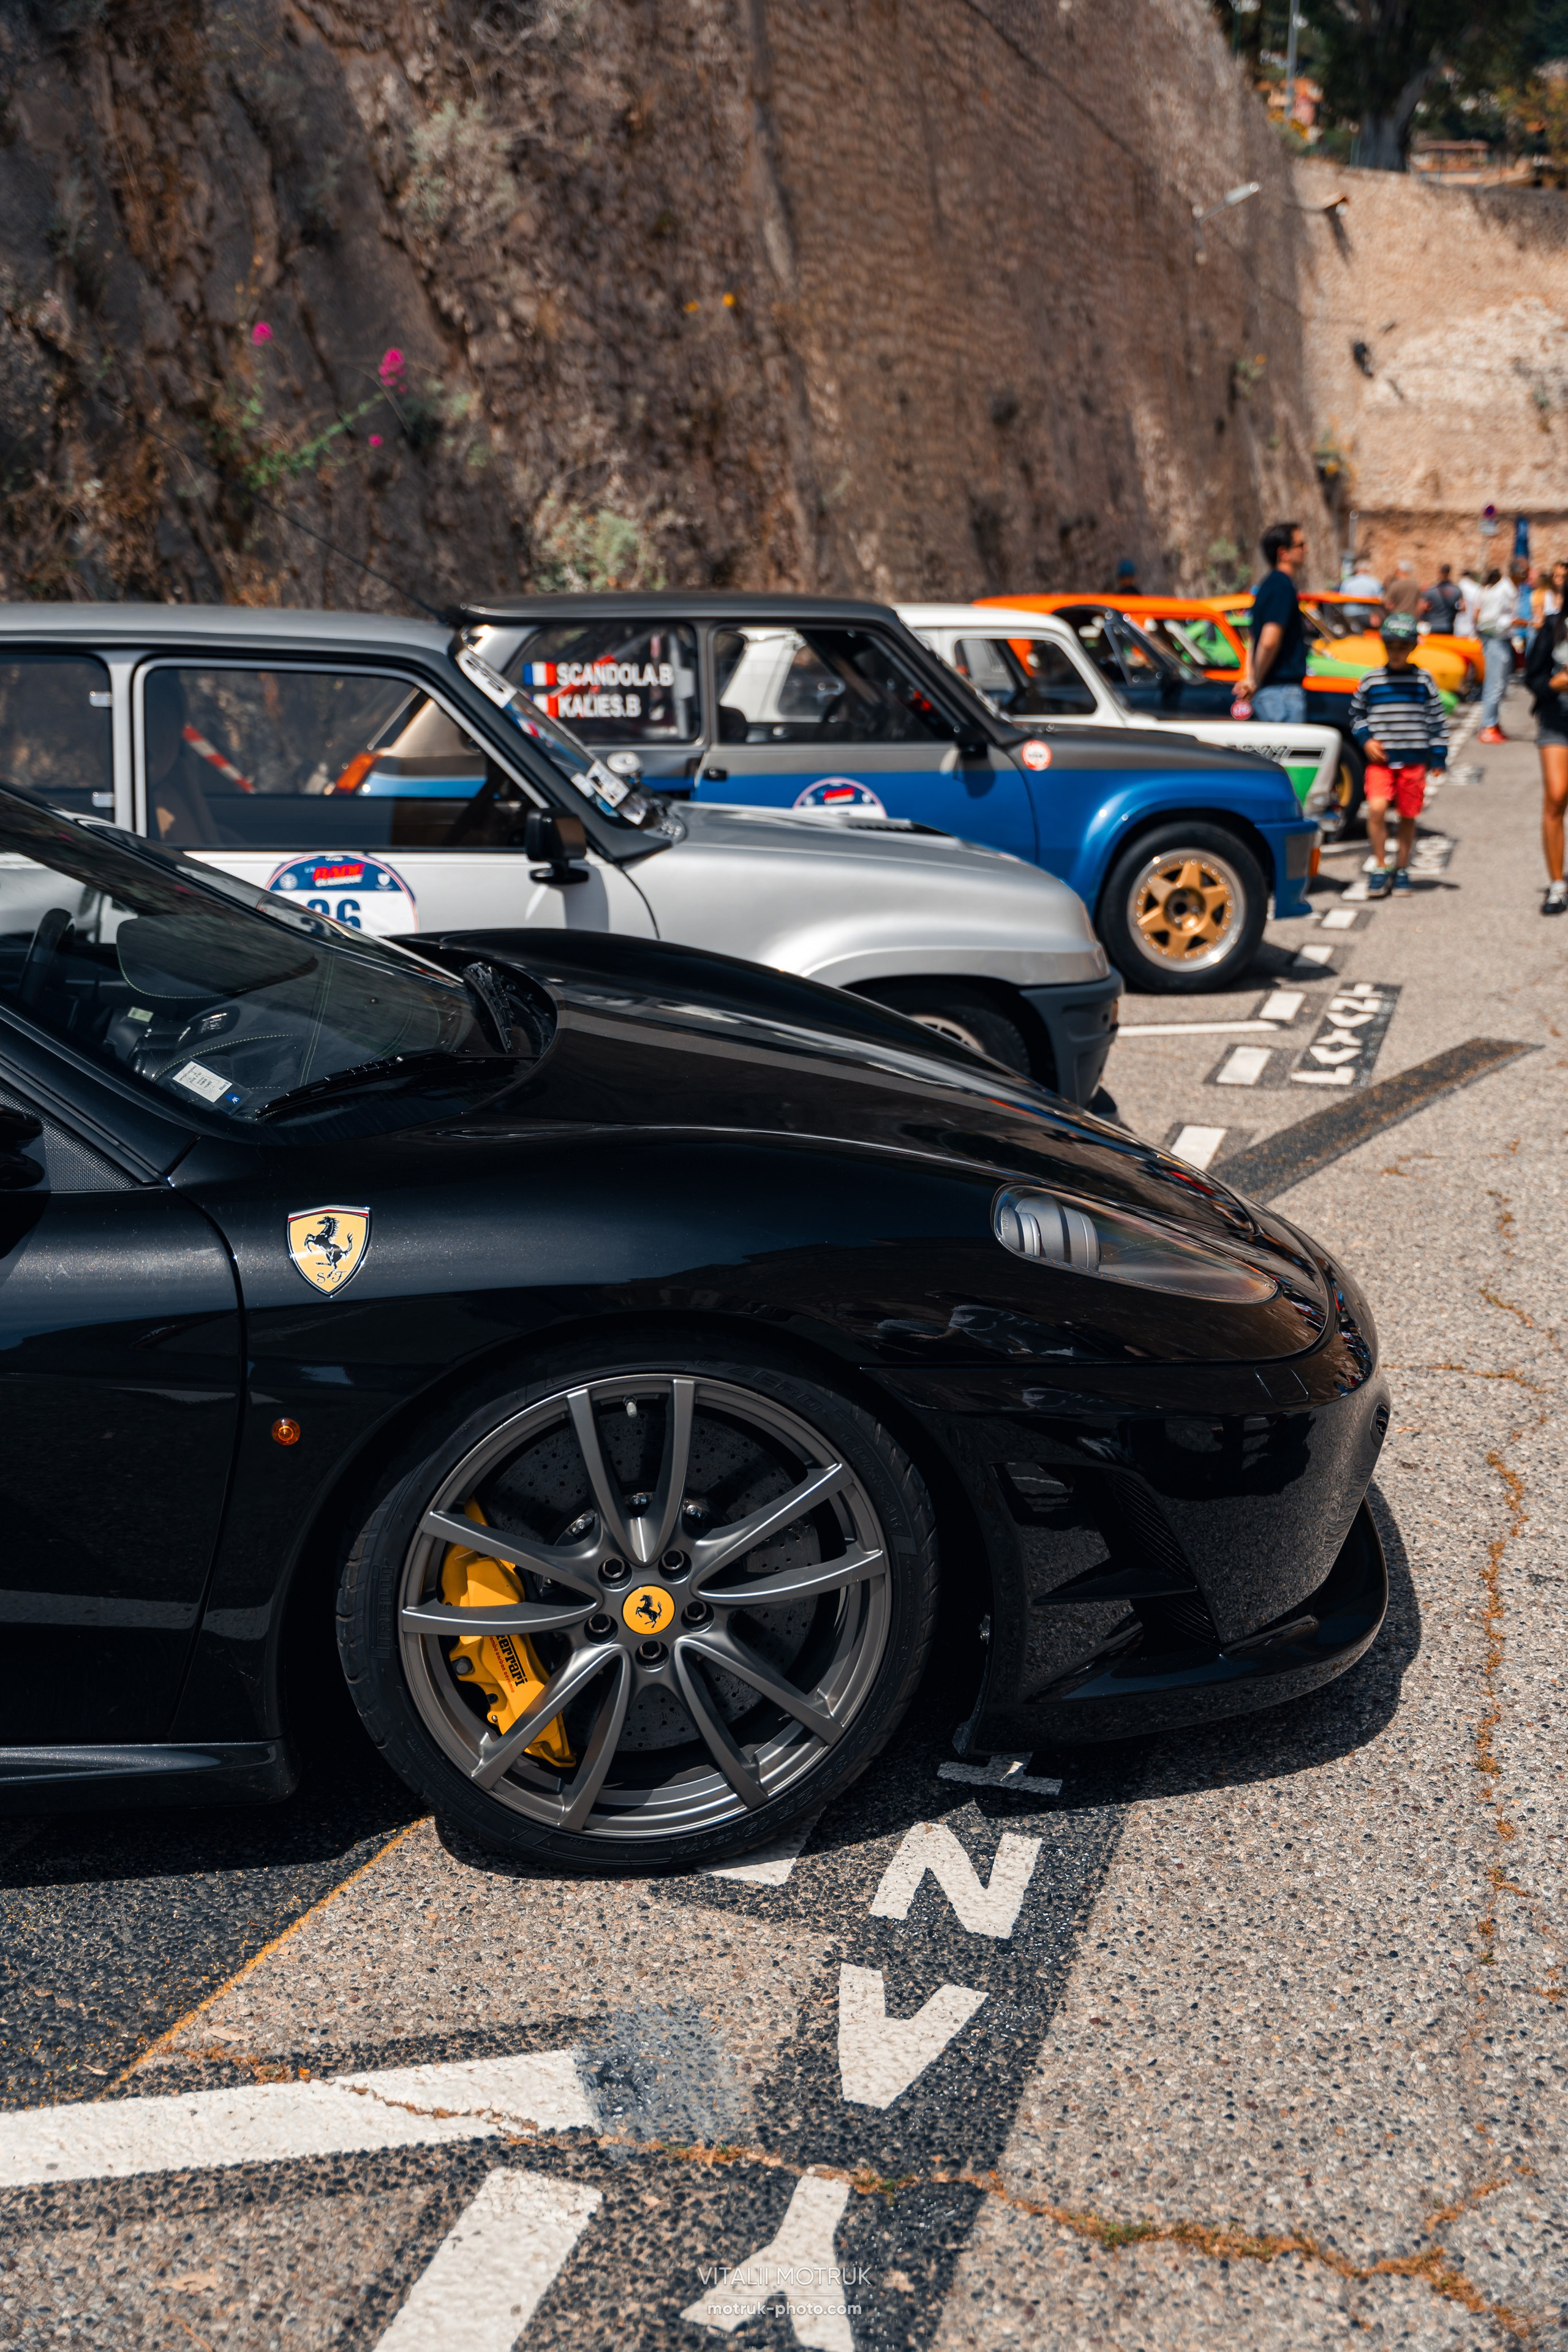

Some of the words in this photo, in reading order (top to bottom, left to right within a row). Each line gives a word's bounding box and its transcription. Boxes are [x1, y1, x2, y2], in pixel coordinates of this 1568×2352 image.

[556, 663, 674, 687] SCANDOLA.B
[558, 694, 641, 718] KALIES.B
[317, 1272, 326, 1284] S
[496, 1652, 506, 1671] carbon
[503, 1672, 515, 1693] ceramic
